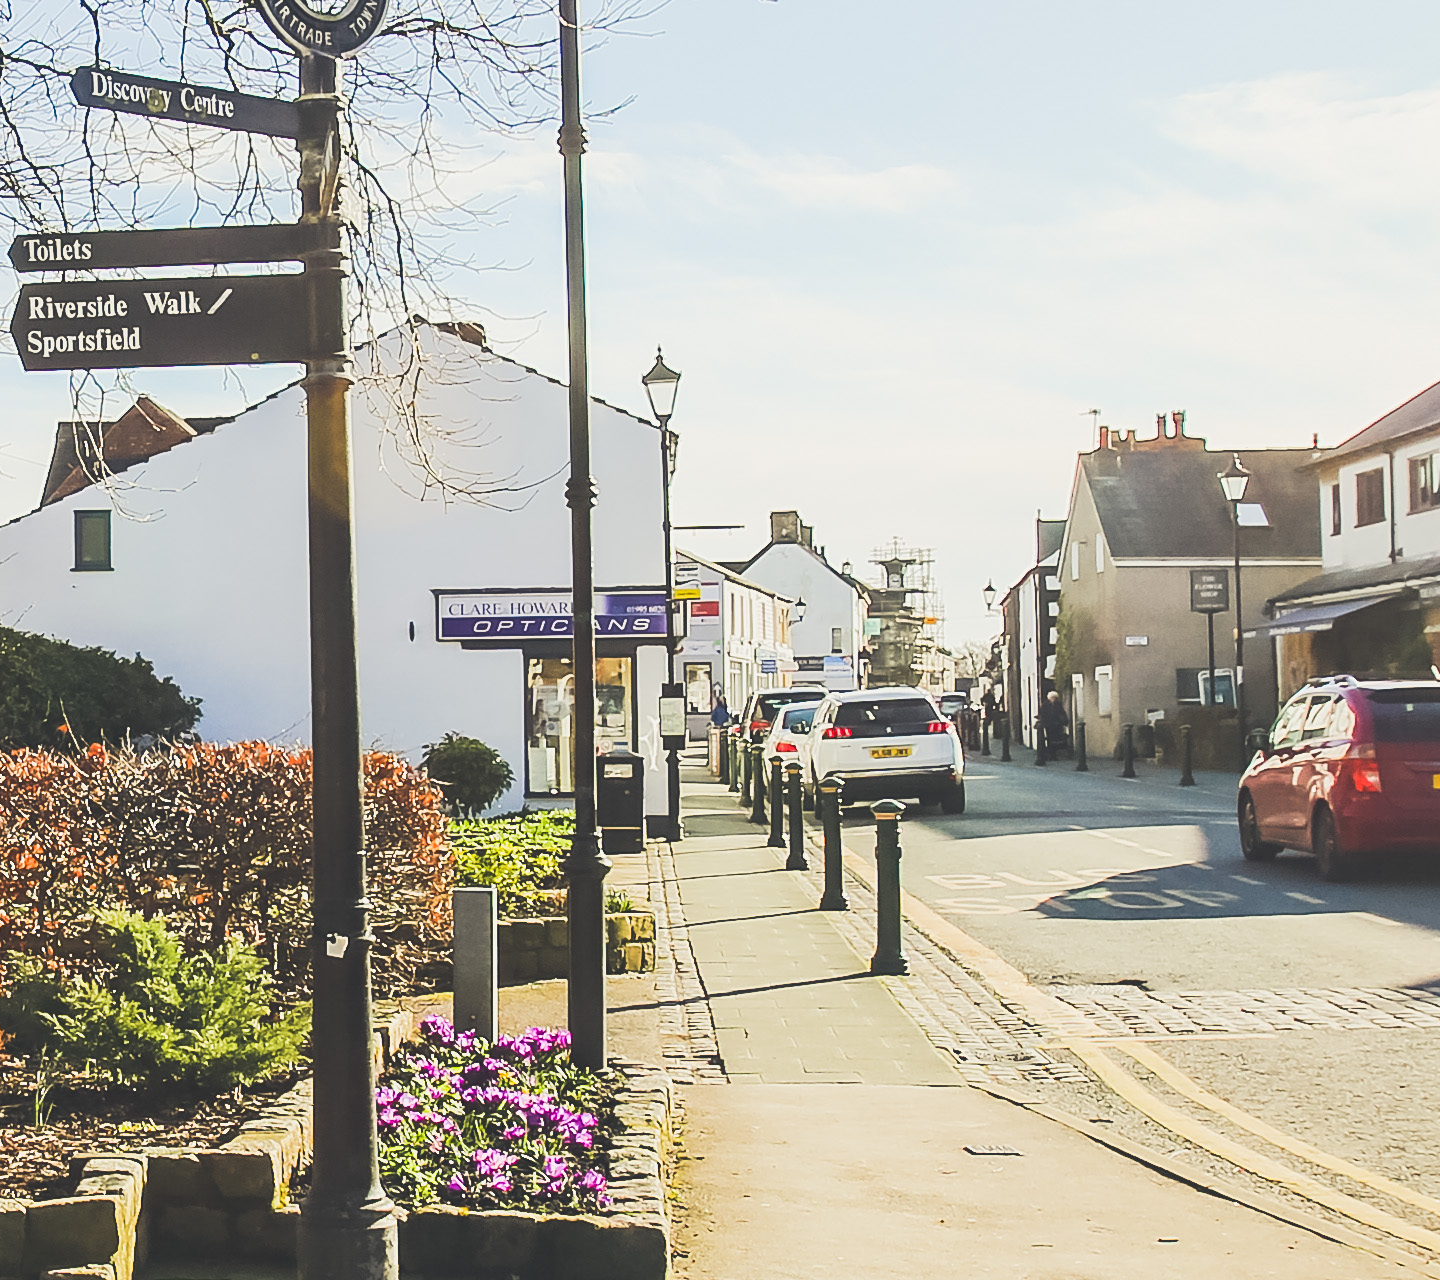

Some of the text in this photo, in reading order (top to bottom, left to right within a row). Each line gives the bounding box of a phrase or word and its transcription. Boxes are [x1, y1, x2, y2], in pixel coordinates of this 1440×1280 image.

[180, 87, 235, 118] Centre
[23, 238, 92, 262] Toilets
[28, 294, 128, 320] Riverside
[143, 290, 201, 315] Walk
[27, 326, 141, 358] Sportsfield
[448, 603, 499, 616] CLARE
[510, 601, 574, 615] HOWAR
[473, 618, 651, 632] OPTICANS
[924, 867, 1158, 891] BUS
[934, 888, 1241, 915] STOP
